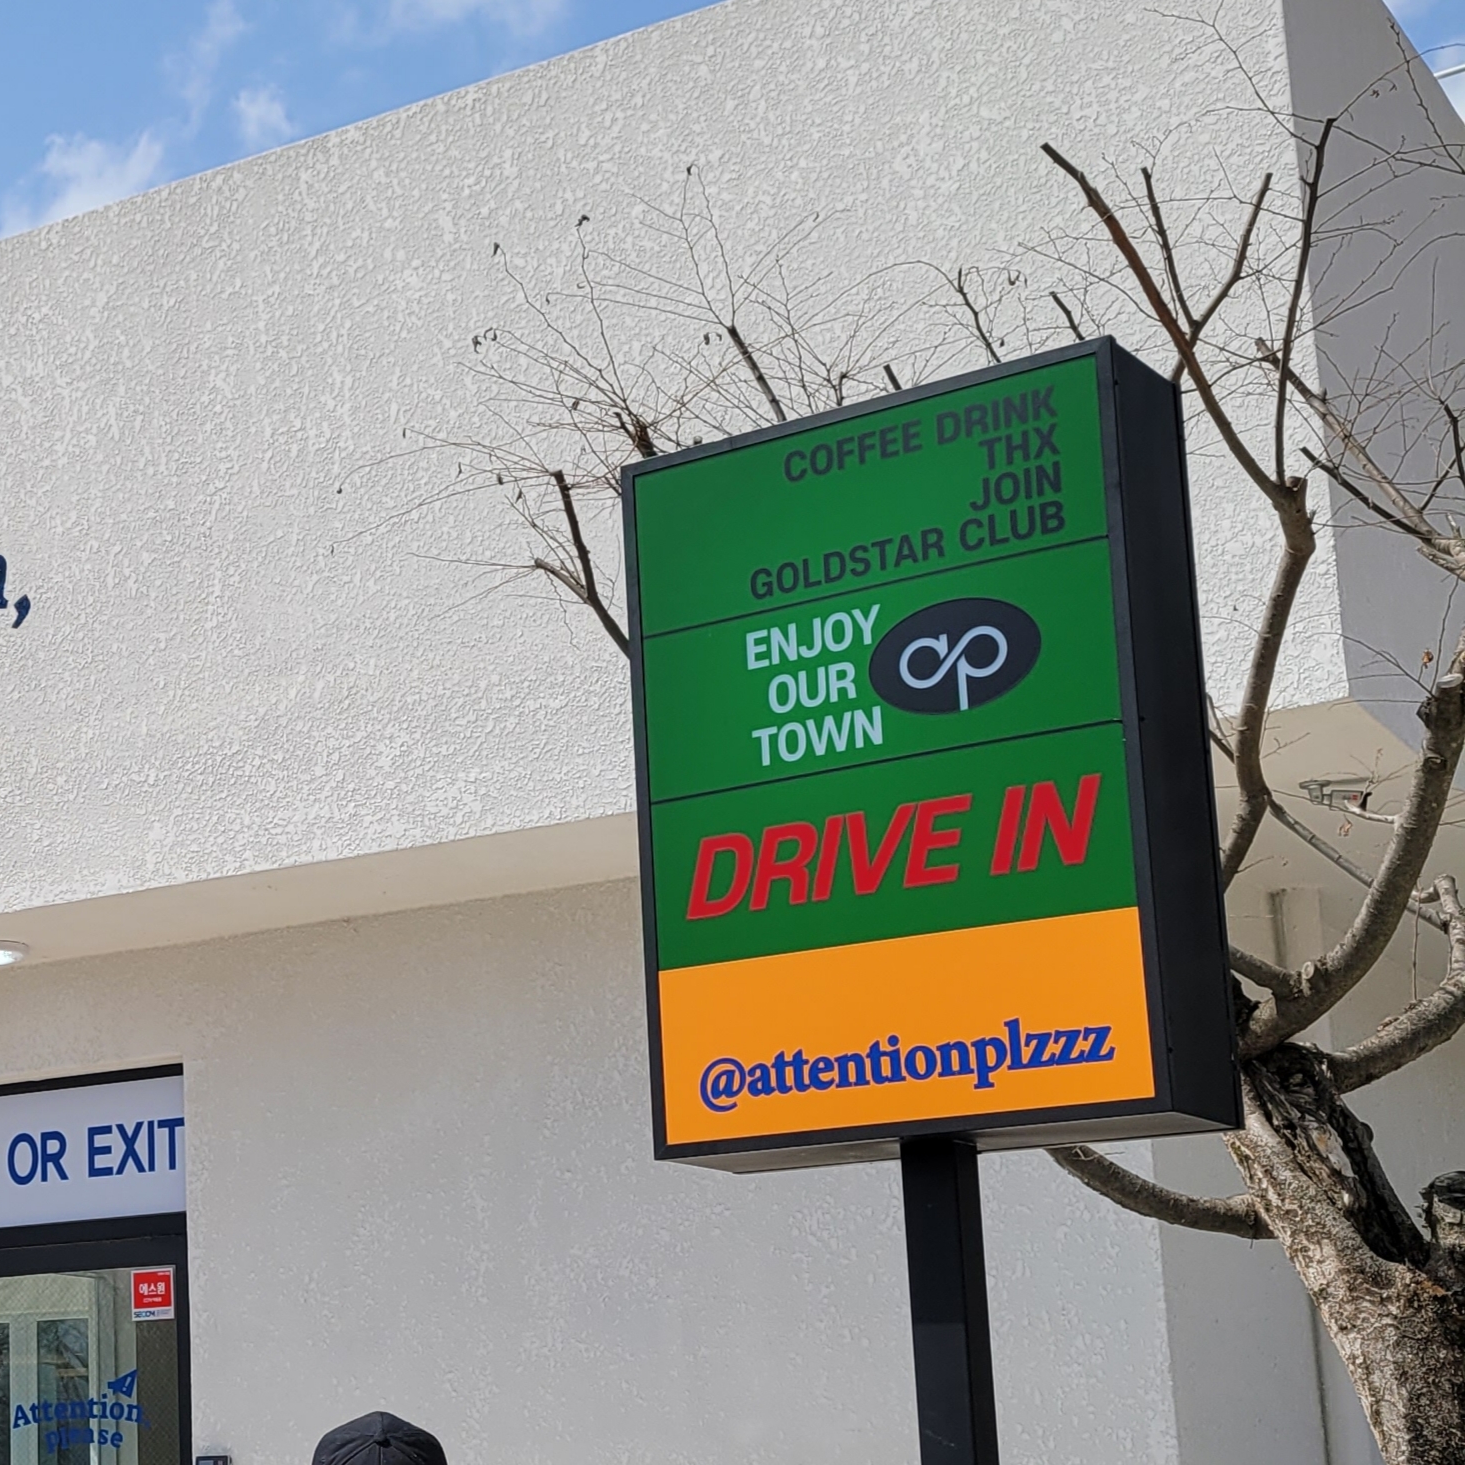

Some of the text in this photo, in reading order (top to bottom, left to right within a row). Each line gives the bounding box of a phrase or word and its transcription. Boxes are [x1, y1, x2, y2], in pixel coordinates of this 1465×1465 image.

[784, 385, 1058, 482] COFFEE DRINK
[978, 422, 1060, 470] THX
[970, 460, 1062, 511] JOIN
[750, 500, 1066, 600] GOLDSTAR CLUB
[745, 603, 881, 671] ENJOY
[767, 661, 857, 714] OUR
[751, 705, 885, 767] TOWN
[686, 773, 1102, 921] DRIVE IN
[699, 1017, 1116, 1113] @attentionplzzz
[7, 1130, 69, 1186] OR
[87, 1117, 185, 1178] EXIT
[138, 1281, 166, 1296] 에스원
